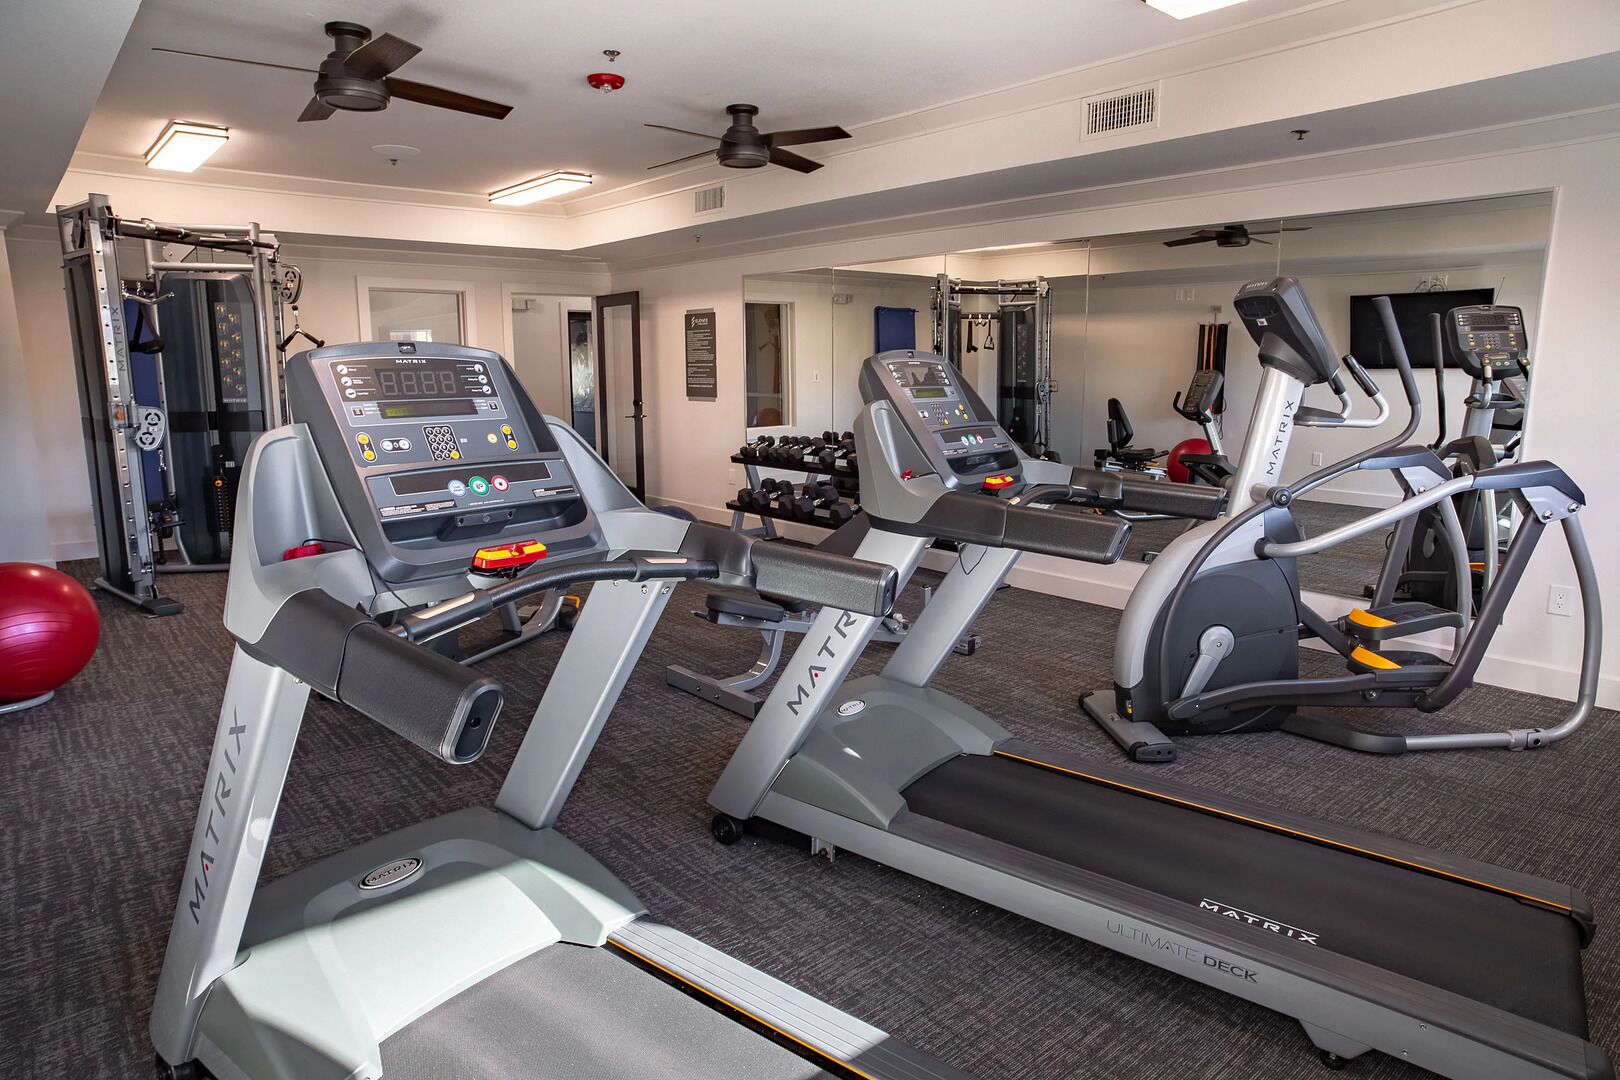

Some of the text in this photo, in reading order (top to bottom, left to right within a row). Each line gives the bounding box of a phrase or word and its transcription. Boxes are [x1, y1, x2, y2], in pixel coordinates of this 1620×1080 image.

[111, 307, 126, 371] MATRIX
[1266, 400, 1295, 476] MATRIX
[787, 610, 857, 716] MATR
[189, 705, 247, 925] MATRIX
[366, 860, 416, 884] MATRIX
[1106, 919, 1258, 984] ULTIMATE DECK
[1200, 900, 1317, 946] MATRIX
